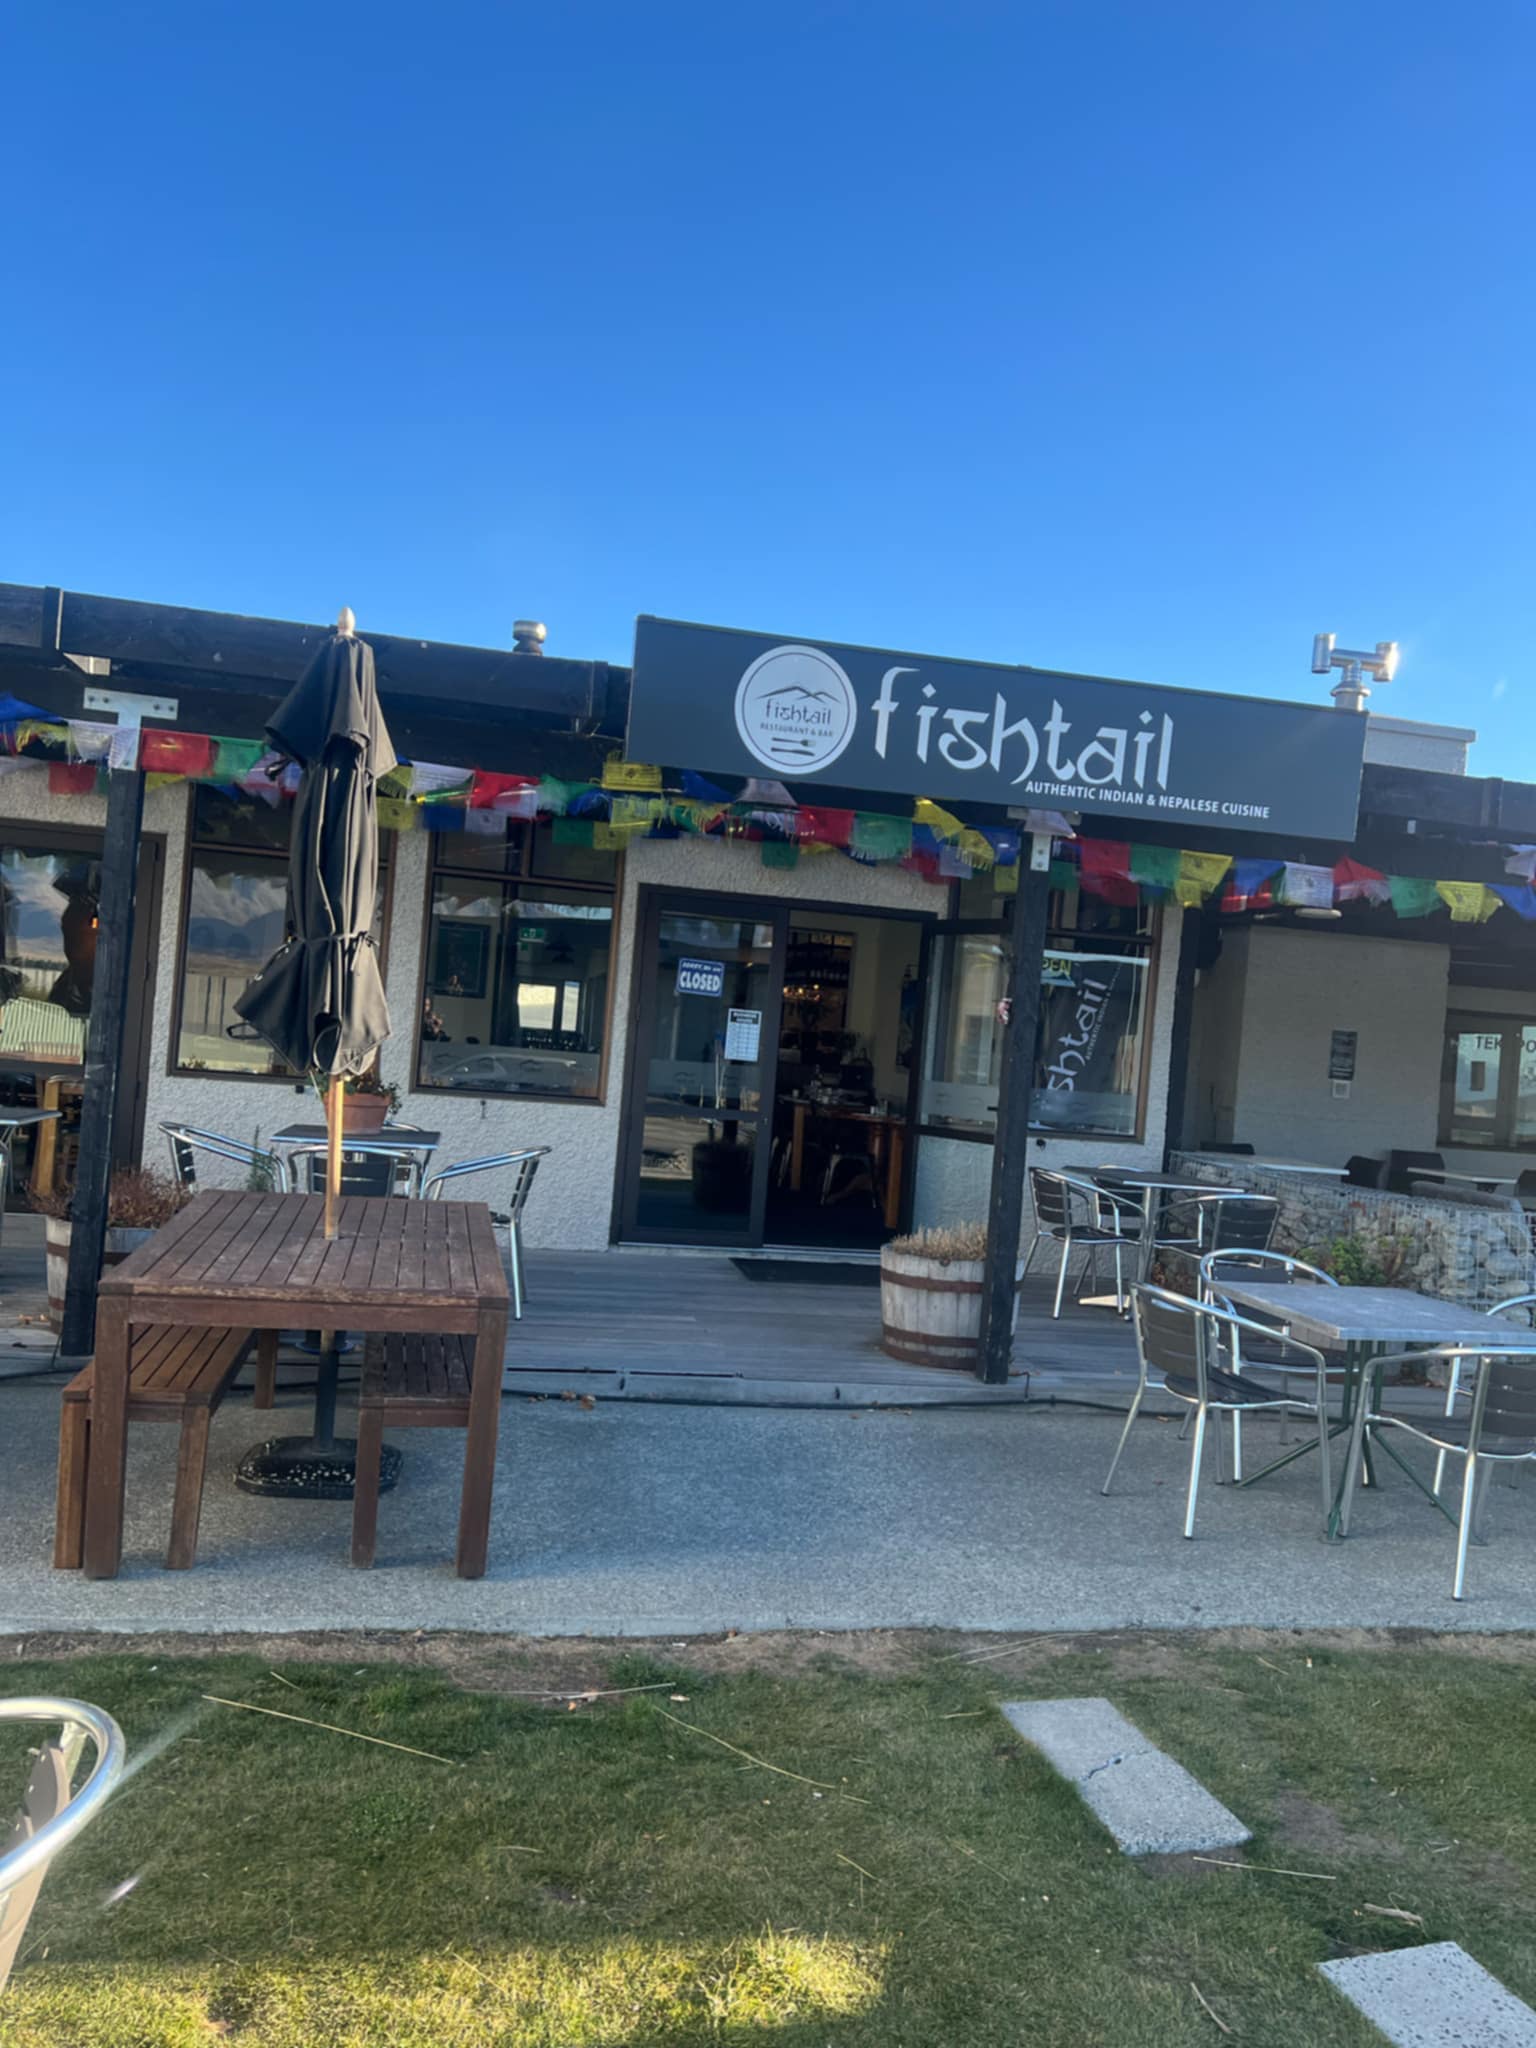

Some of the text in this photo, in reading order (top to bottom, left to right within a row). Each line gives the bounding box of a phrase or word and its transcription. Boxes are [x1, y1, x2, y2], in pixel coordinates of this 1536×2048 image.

[765, 699, 832, 726] fishtail
[871, 666, 1174, 791] fishtail
[1025, 781, 1271, 819] AUTHENTIC INDIAN & NEPALESE CUISINE
[680, 970, 721, 992] CLOSED
